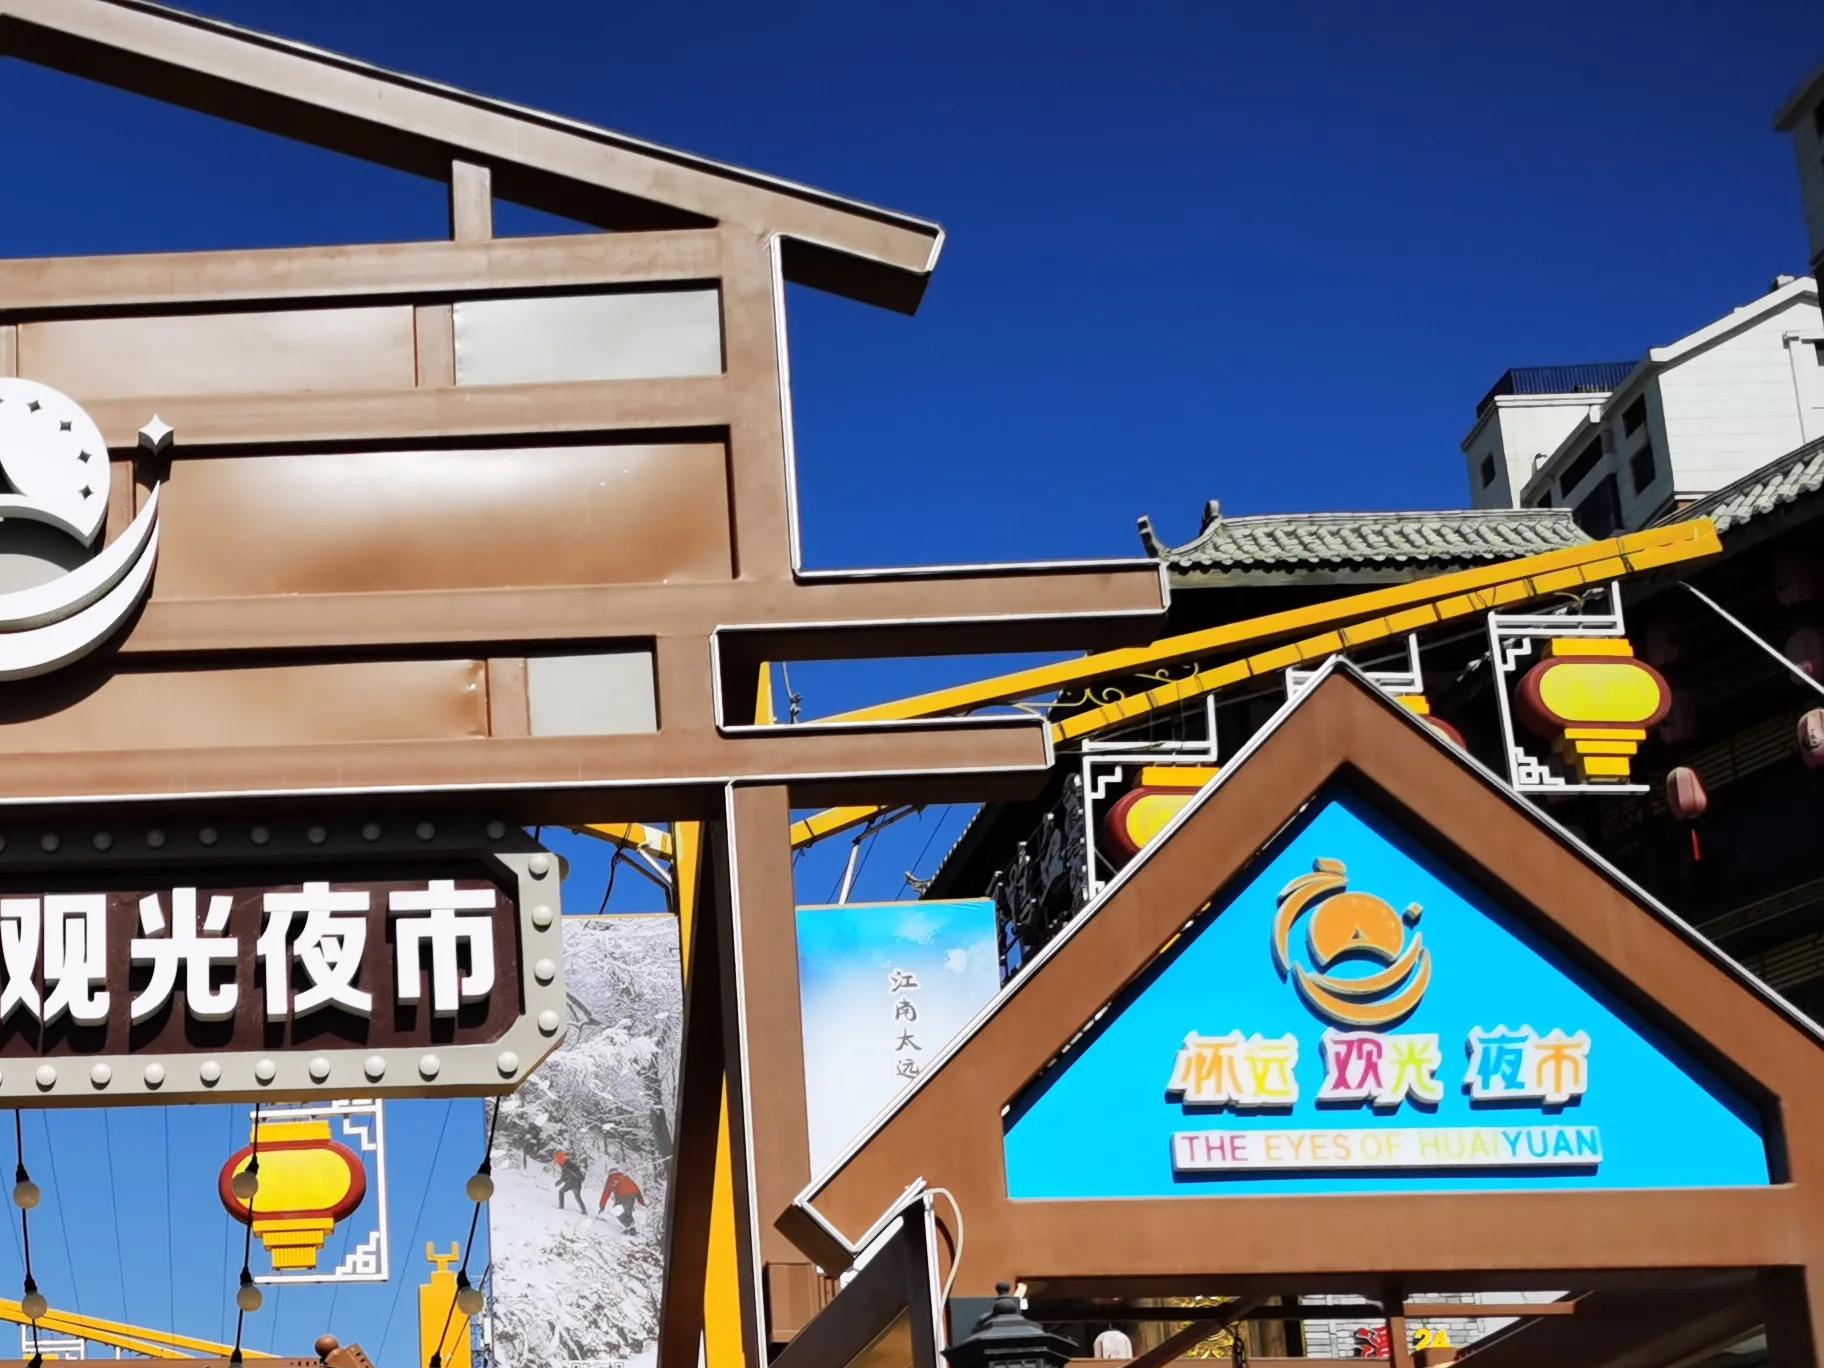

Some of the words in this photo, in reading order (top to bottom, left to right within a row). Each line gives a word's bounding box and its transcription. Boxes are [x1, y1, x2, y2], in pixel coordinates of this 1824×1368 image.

[890, 970, 922, 1080] 江南太远
[1183, 1041, 1293, 1096] 怀远
[1478, 1035, 1583, 1093] 夜市
[1180, 1134, 1248, 1162] THE
[1265, 1133, 1352, 1161] EYES
[1360, 1132, 1405, 1160] OF
[1420, 1129, 1599, 1158] HUAIYUAN
